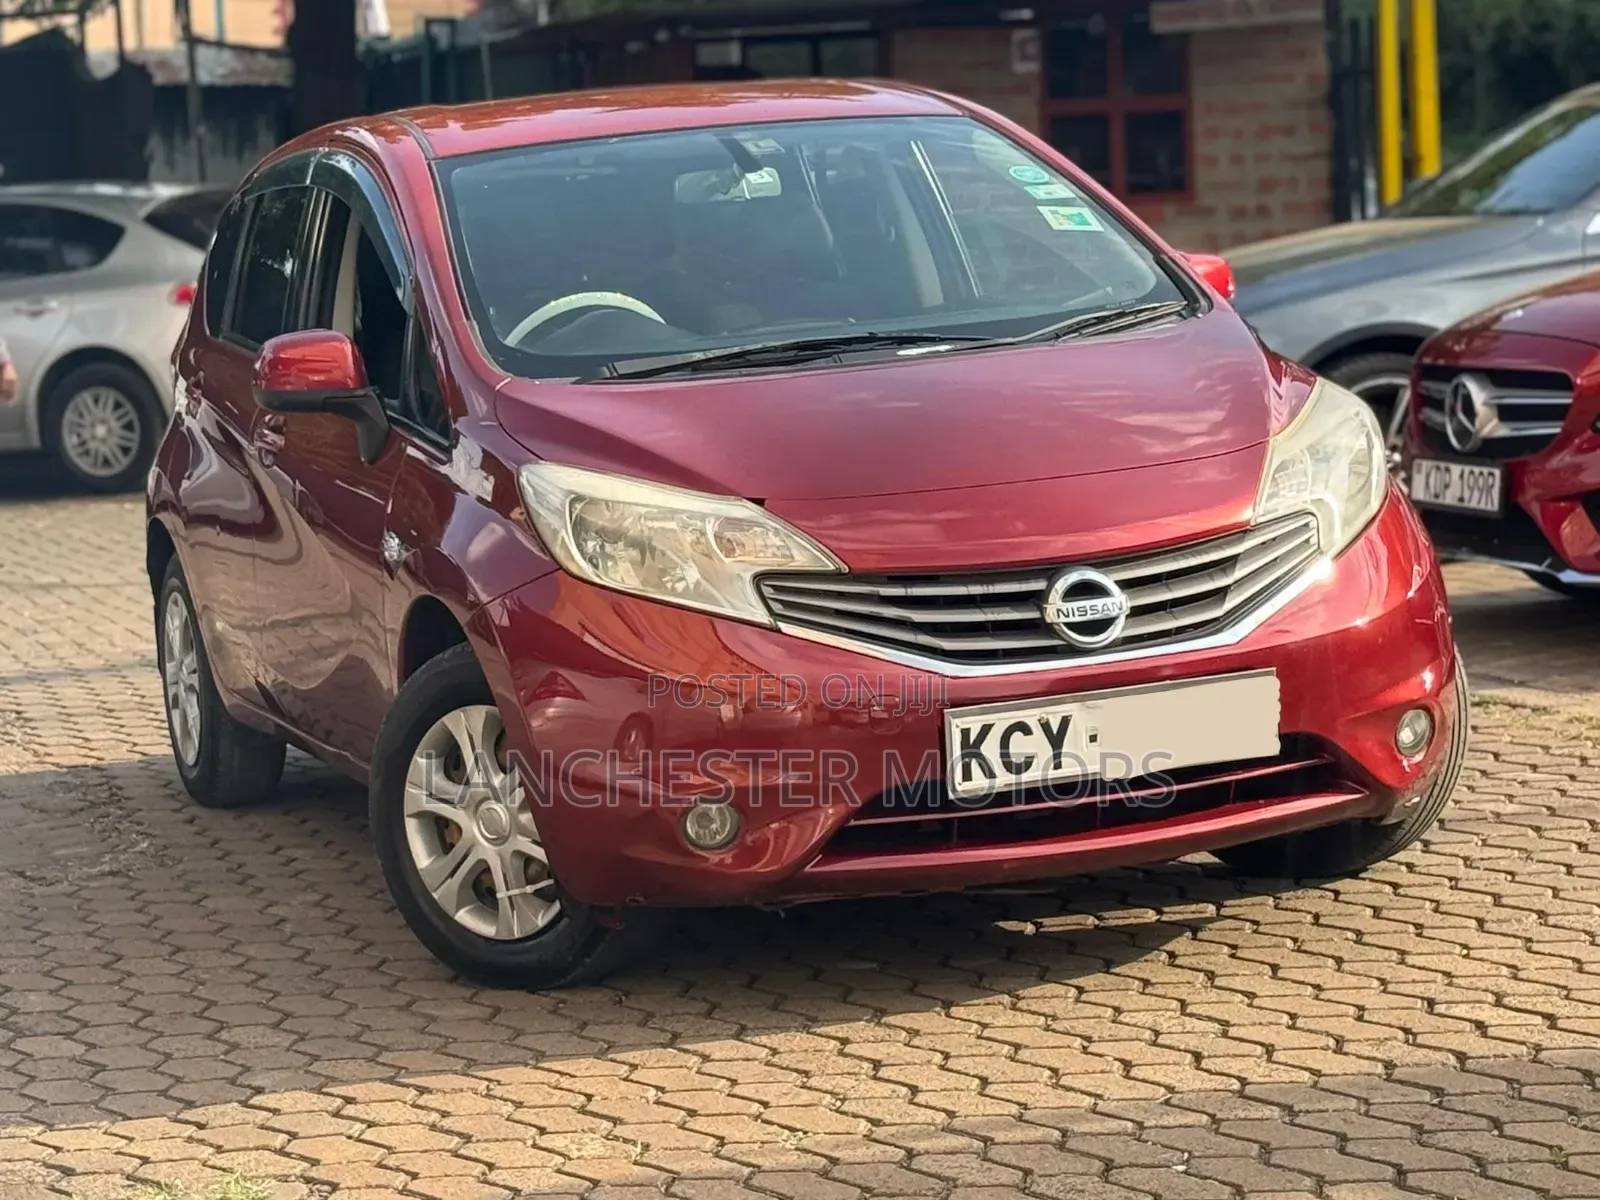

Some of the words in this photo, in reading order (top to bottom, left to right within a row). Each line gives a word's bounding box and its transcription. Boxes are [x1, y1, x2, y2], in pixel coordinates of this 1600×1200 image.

[1424, 464, 1452, 502] KDP
[1457, 467, 1496, 508] 199R
[1056, 601, 1124, 619] NISSAN
[960, 714, 1074, 783] KCY
